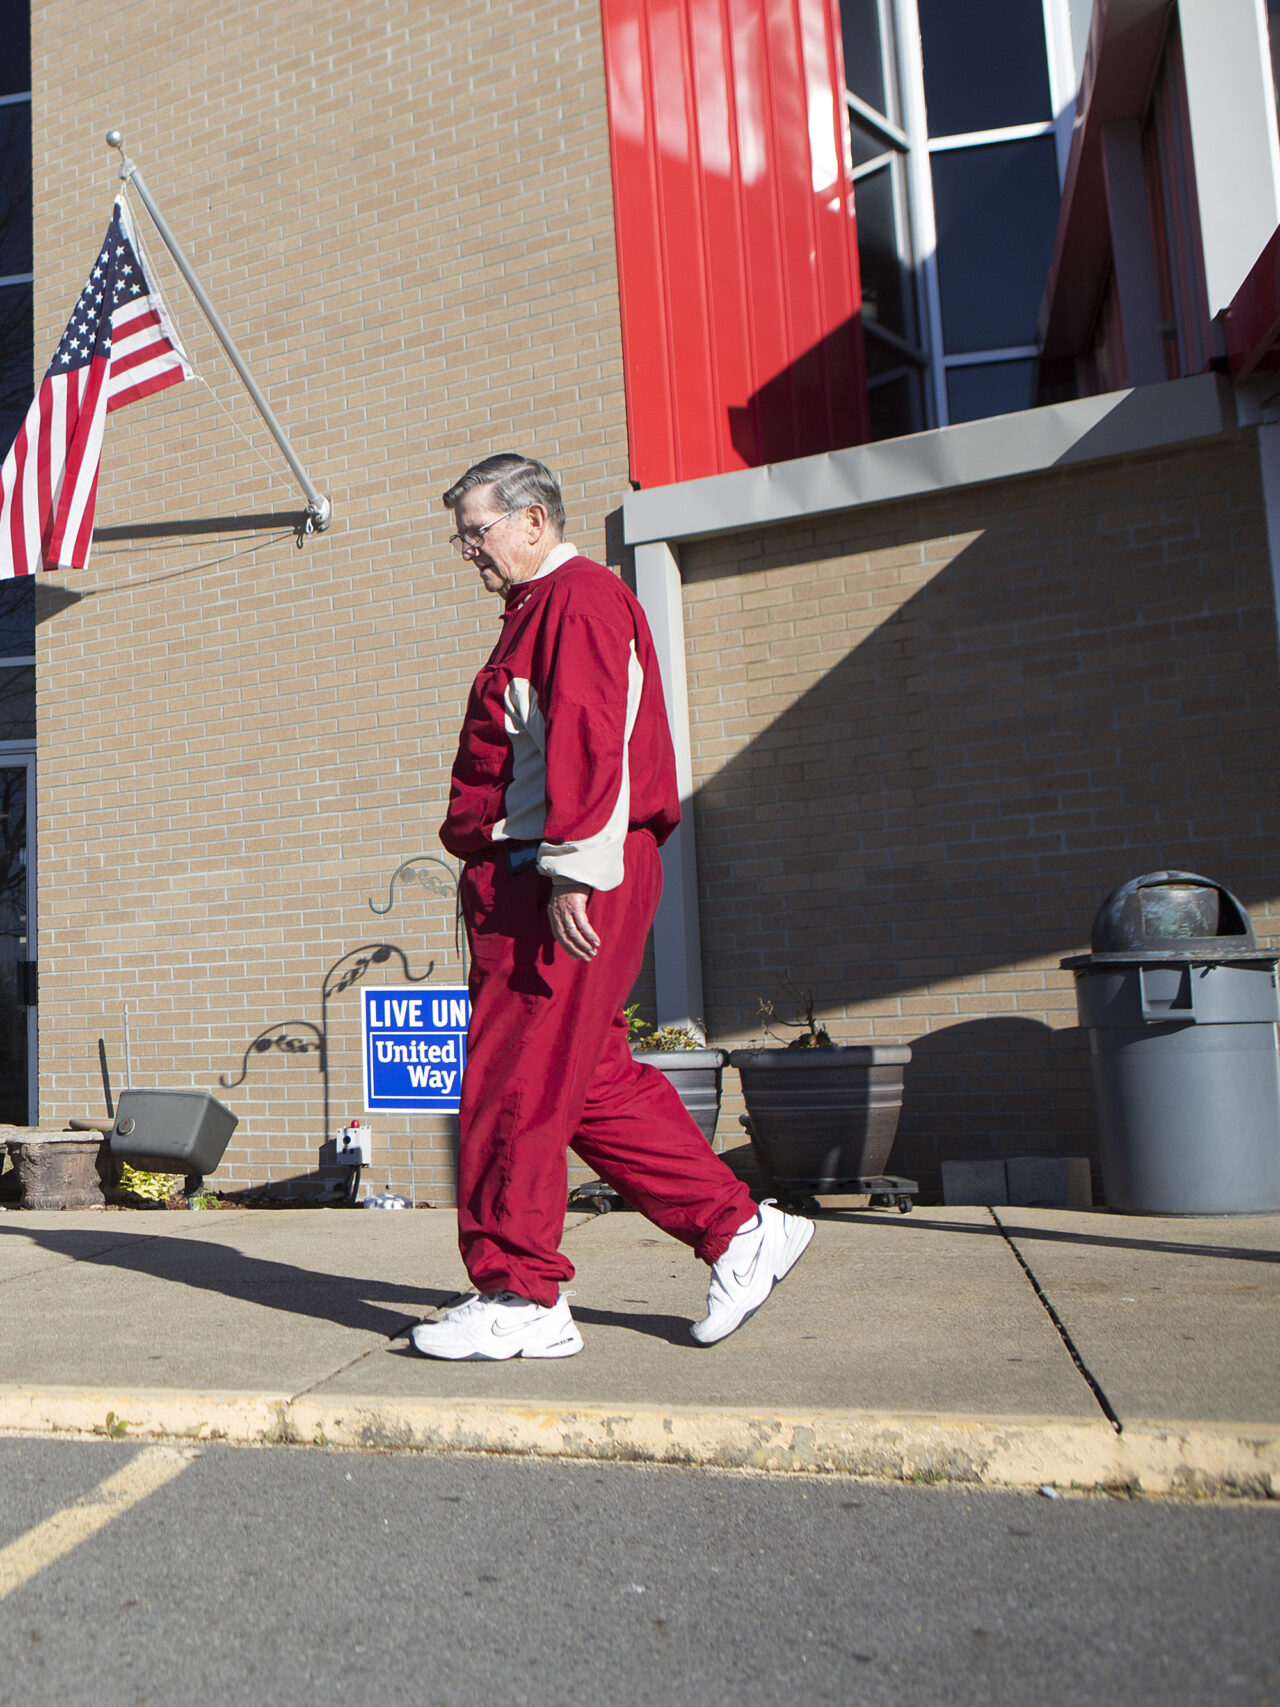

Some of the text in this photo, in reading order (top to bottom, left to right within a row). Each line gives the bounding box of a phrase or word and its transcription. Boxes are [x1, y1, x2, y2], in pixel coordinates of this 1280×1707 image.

[370, 1000, 423, 1027] LIVE
[376, 1040, 457, 1063] United
[407, 1065, 457, 1094] Way
